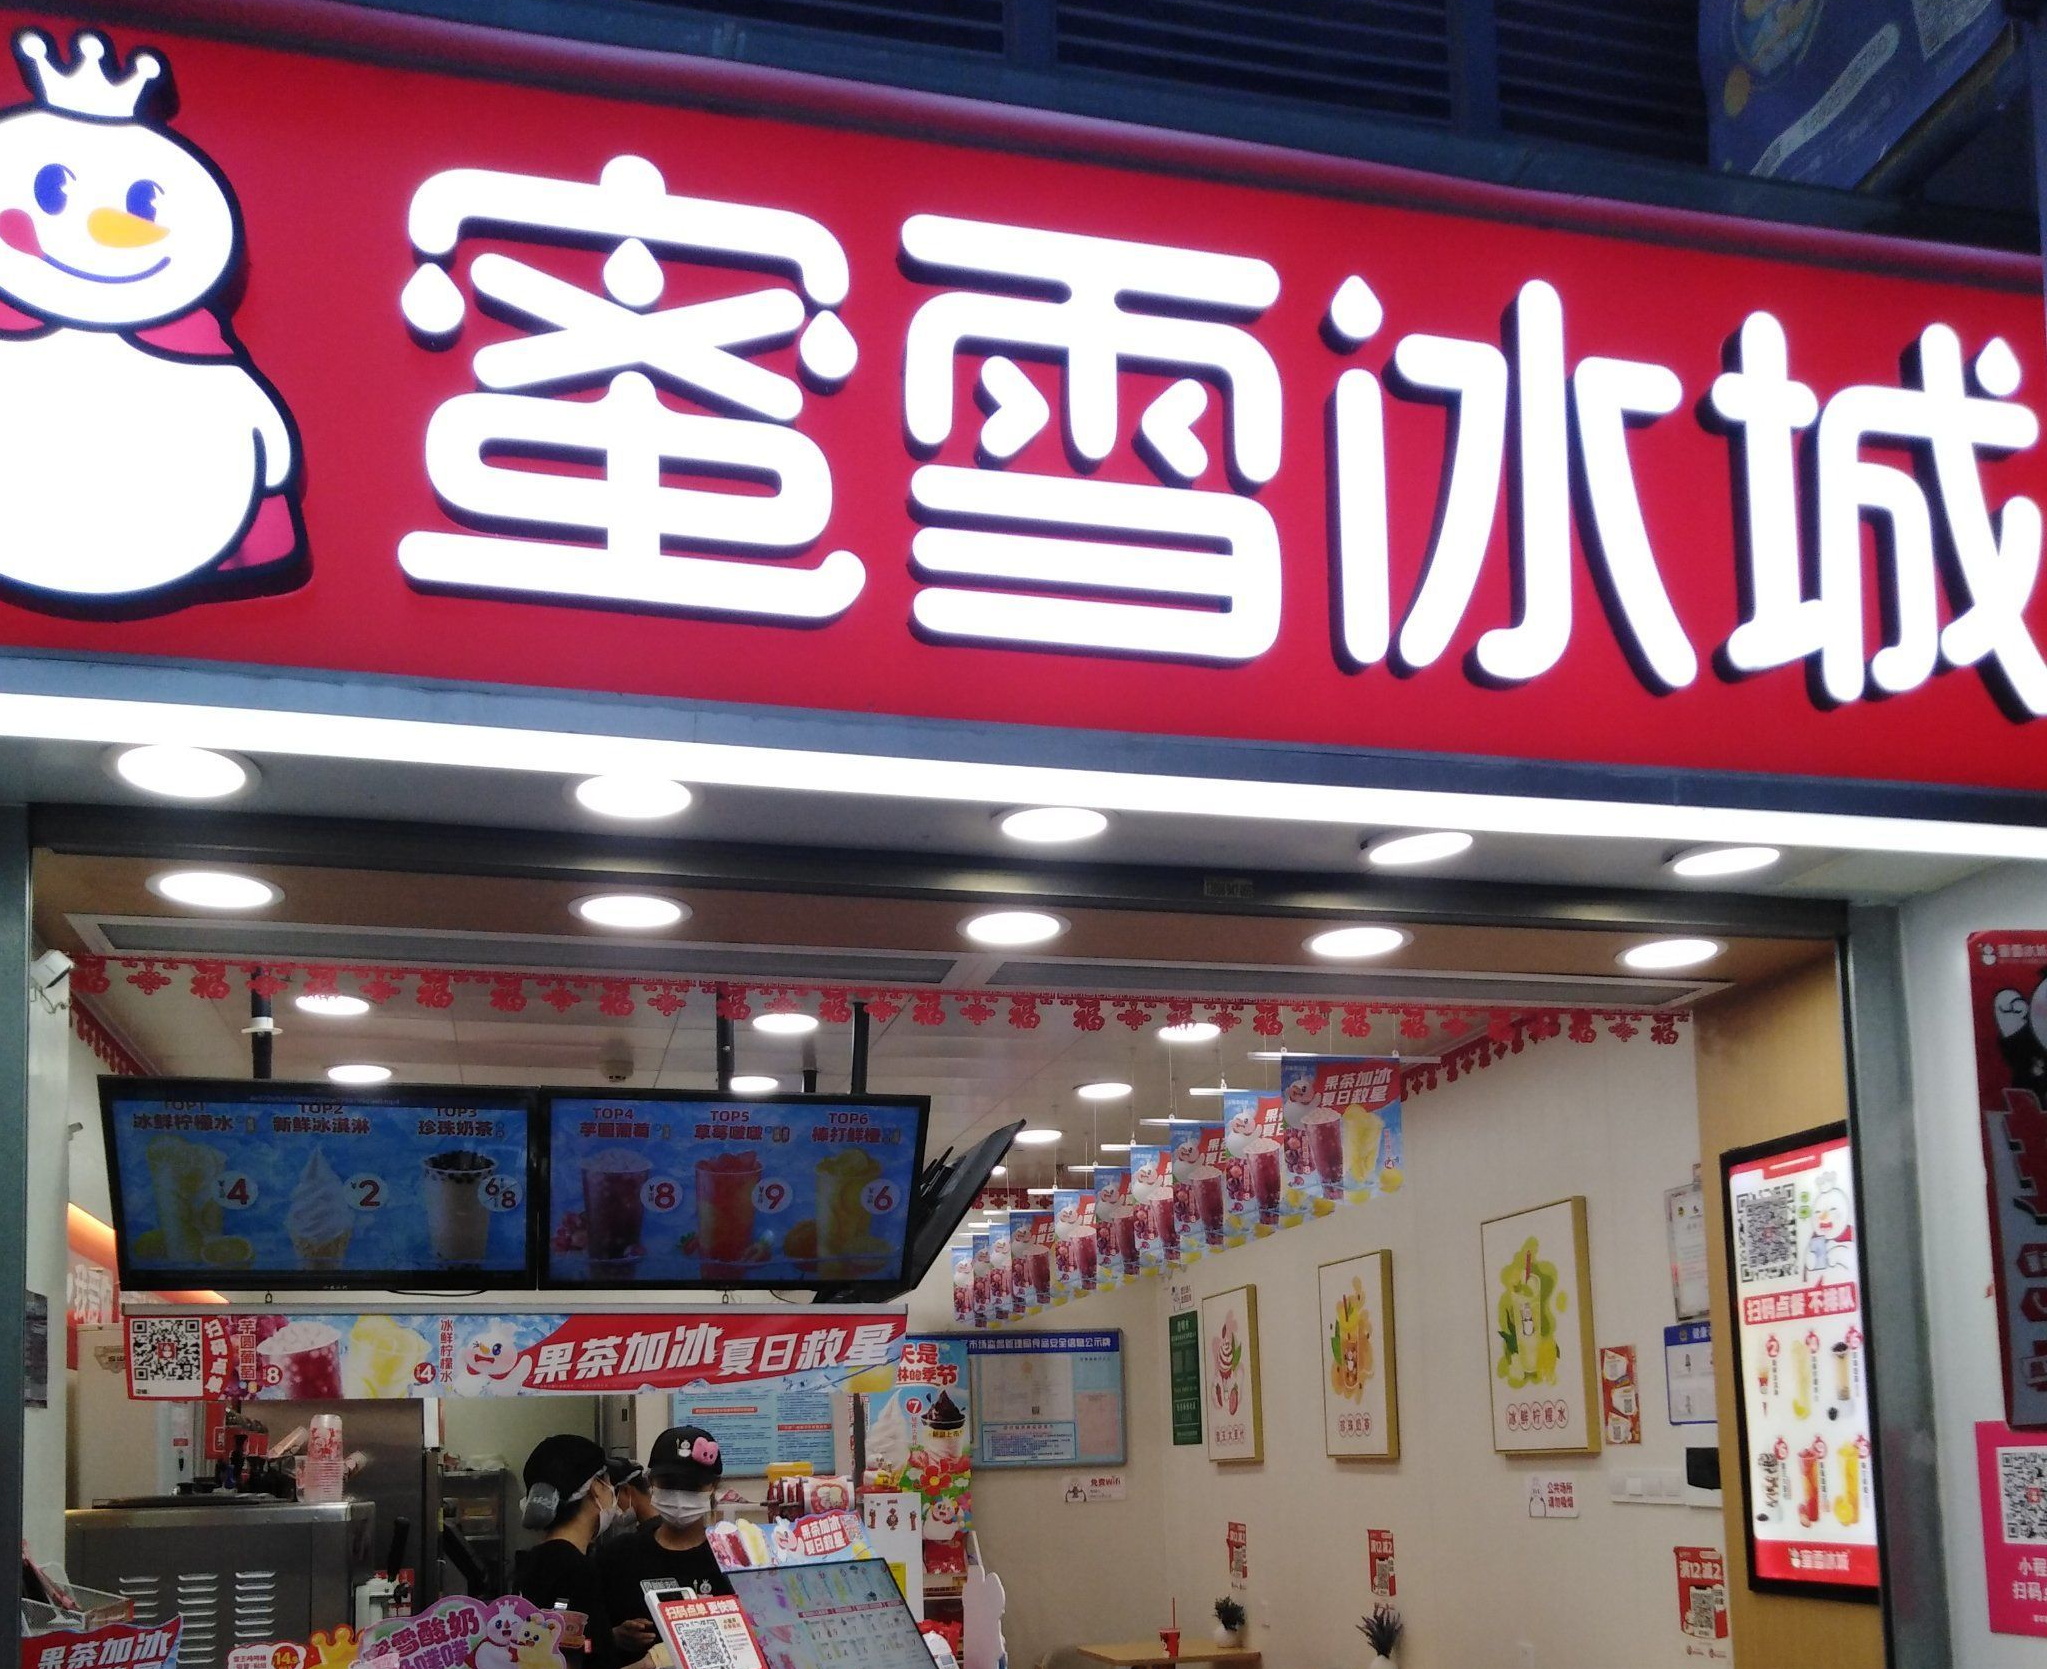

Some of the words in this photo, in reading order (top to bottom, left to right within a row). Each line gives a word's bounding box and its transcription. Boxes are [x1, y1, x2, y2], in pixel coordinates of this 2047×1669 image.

[398, 153, 2047, 722] 蜜雪冰城
[1325, 1067, 1393, 1091] 果茶加冰
[1321, 1085, 1388, 1107] 夏日救星
[299, 1104, 344, 1115] TOP2
[435, 1107, 478, 1118] TOP3
[593, 1108, 634, 1120] TOP4
[709, 1110, 750, 1122] TOP5
[133, 1113, 234, 1132] 冰鲜柠檬水
[273, 1117, 371, 1135] 新鲜冰淇淋
[418, 1119, 493, 1137] 珍珠奶茶
[828, 1113, 869, 1125] TOP6
[238, 1318, 257, 1381] 芋圆葡萄
[440, 1319, 454, 1383] 冰鲜柠檬水
[965, 1336, 1111, 1350] 市场监督管理局食品安全信息公示牌
[1507, 1406, 1567, 1426] 冰鲜柠檬水
[1547, 1481, 1573, 1494] 公共场所
[1547, 1496, 1574, 1509] 请勿吸烟
[800, 1514, 842, 1540] 果茶加冰
[804, 1531, 847, 1556] 夏日救星
[38, 1629, 173, 1669] 果茶加冰
